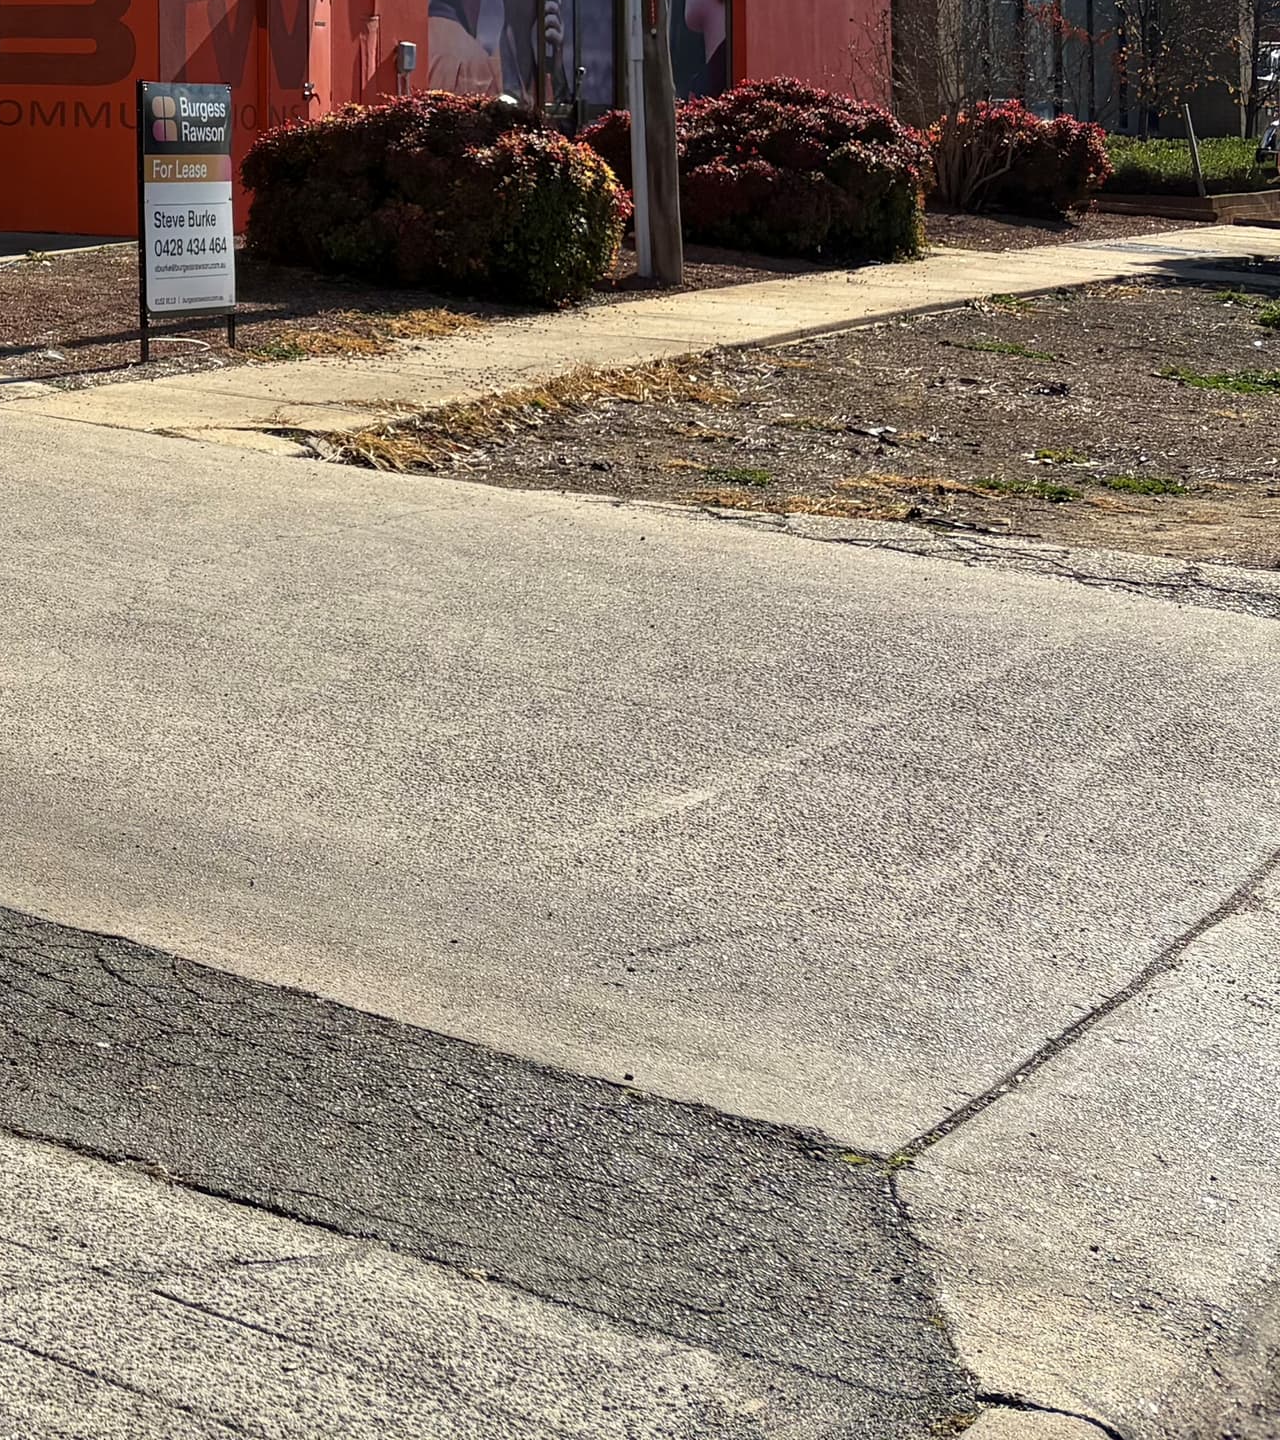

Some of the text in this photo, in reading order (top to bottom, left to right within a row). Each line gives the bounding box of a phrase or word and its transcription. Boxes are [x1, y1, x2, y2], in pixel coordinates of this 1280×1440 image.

[179, 96, 226, 122] Burgess
[181, 120, 225, 142] Rawson
[153, 159, 208, 178] For Lease
[153, 209, 217, 229] Steve Burke
[154, 236, 227, 257] 0428 434 464
